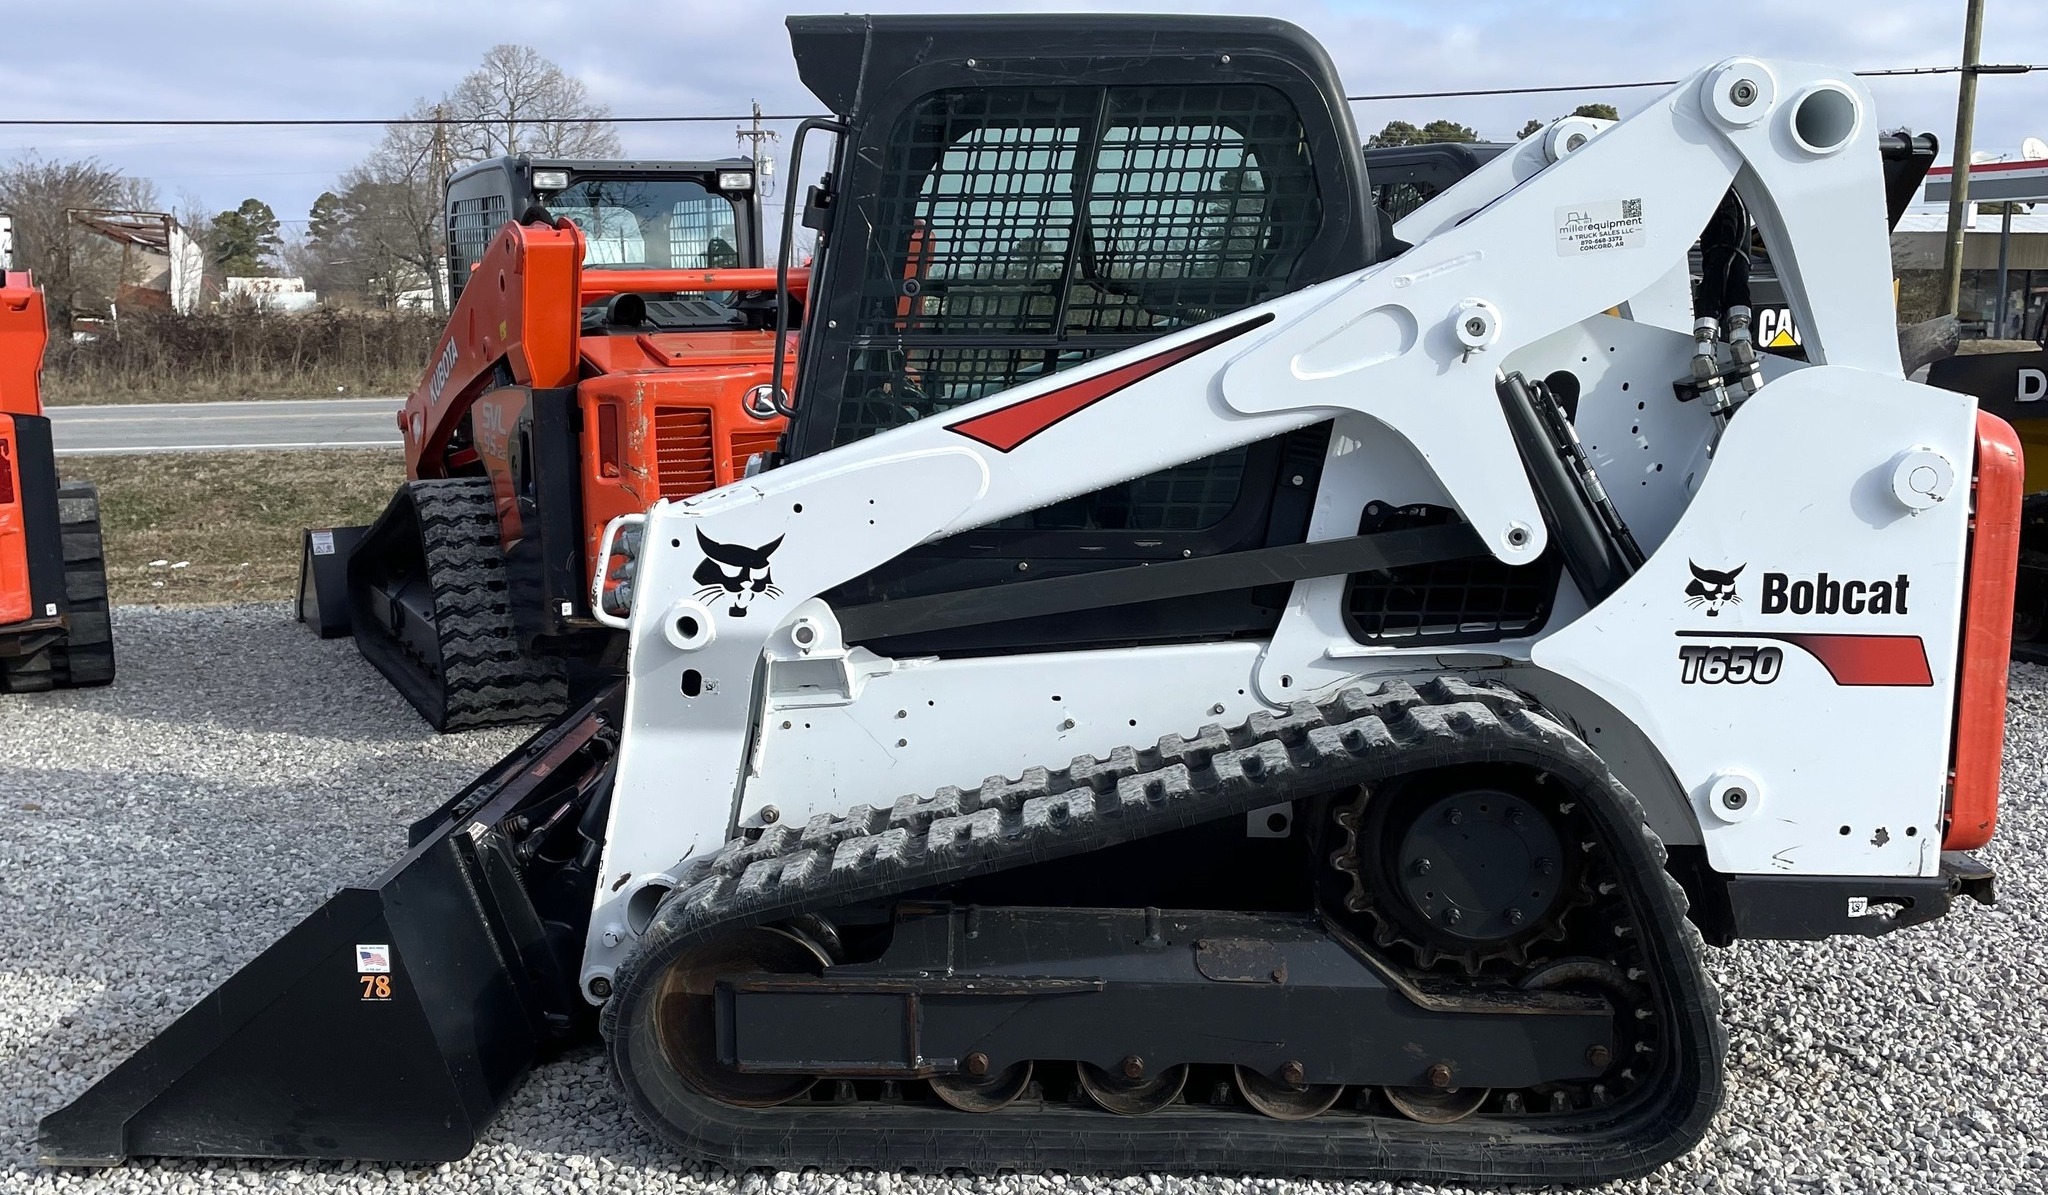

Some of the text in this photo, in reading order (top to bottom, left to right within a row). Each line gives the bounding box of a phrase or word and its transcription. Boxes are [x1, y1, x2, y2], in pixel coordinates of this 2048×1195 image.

[1575, 232, 1597, 240] TRUCK
[1600, 229, 1620, 237] SALES
[1580, 243, 1614, 251] CONCORD,
[429, 336, 459, 406] KUBOTA
[482, 401, 507, 435] SVL
[1761, 572, 1910, 615] Bobcat
[1679, 645, 1784, 685] T650
[360, 975, 391, 998] 78
